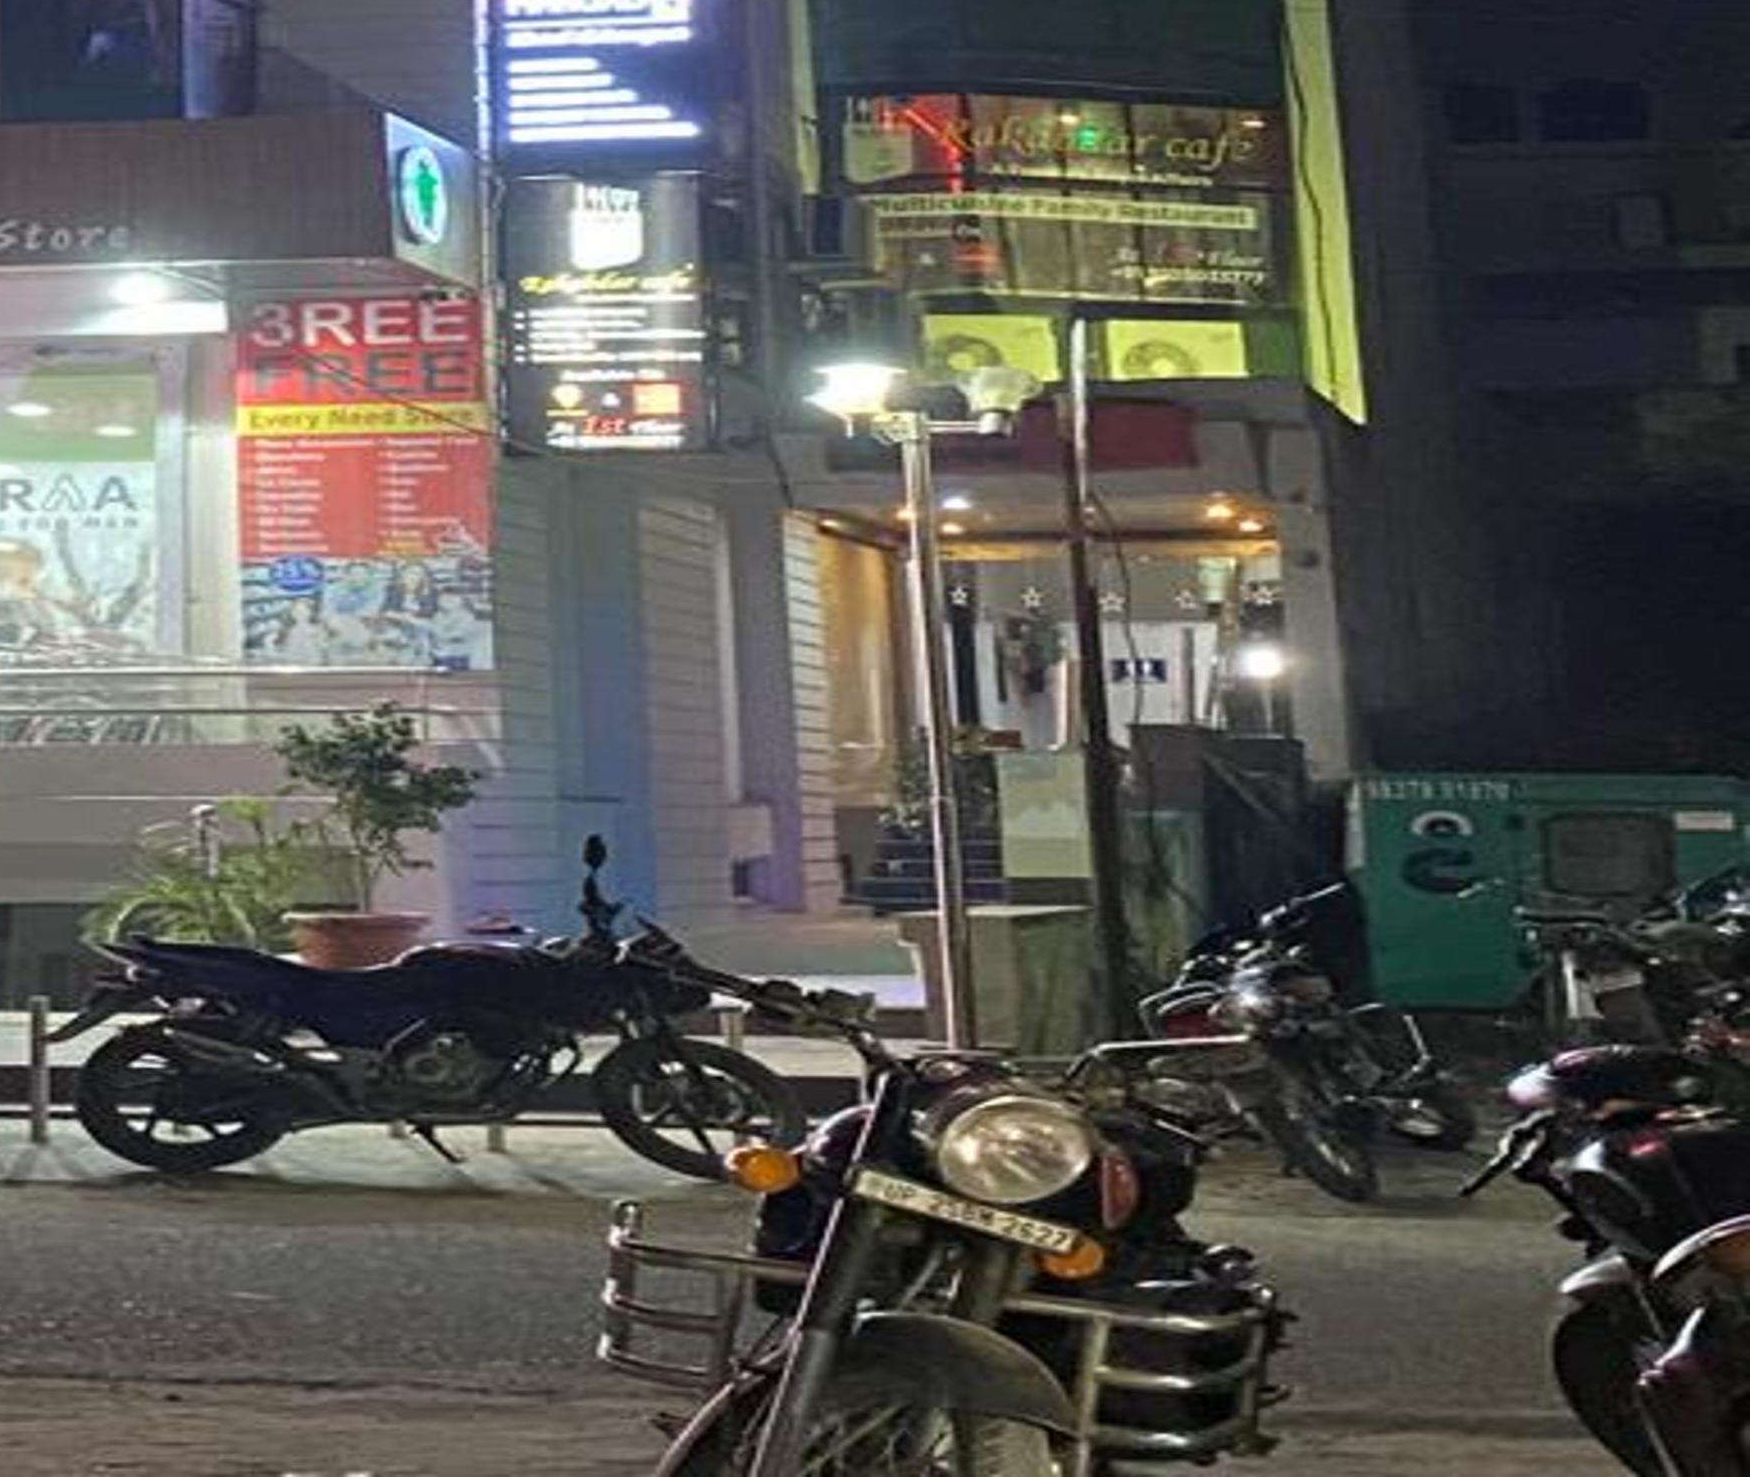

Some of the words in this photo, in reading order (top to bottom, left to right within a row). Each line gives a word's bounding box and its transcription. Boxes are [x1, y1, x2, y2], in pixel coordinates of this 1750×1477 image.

[252, 299, 470, 348] 3REE
[254, 351, 471, 397] FREE
[250, 411, 319, 430] Every
[328, 407, 397, 426] Need
